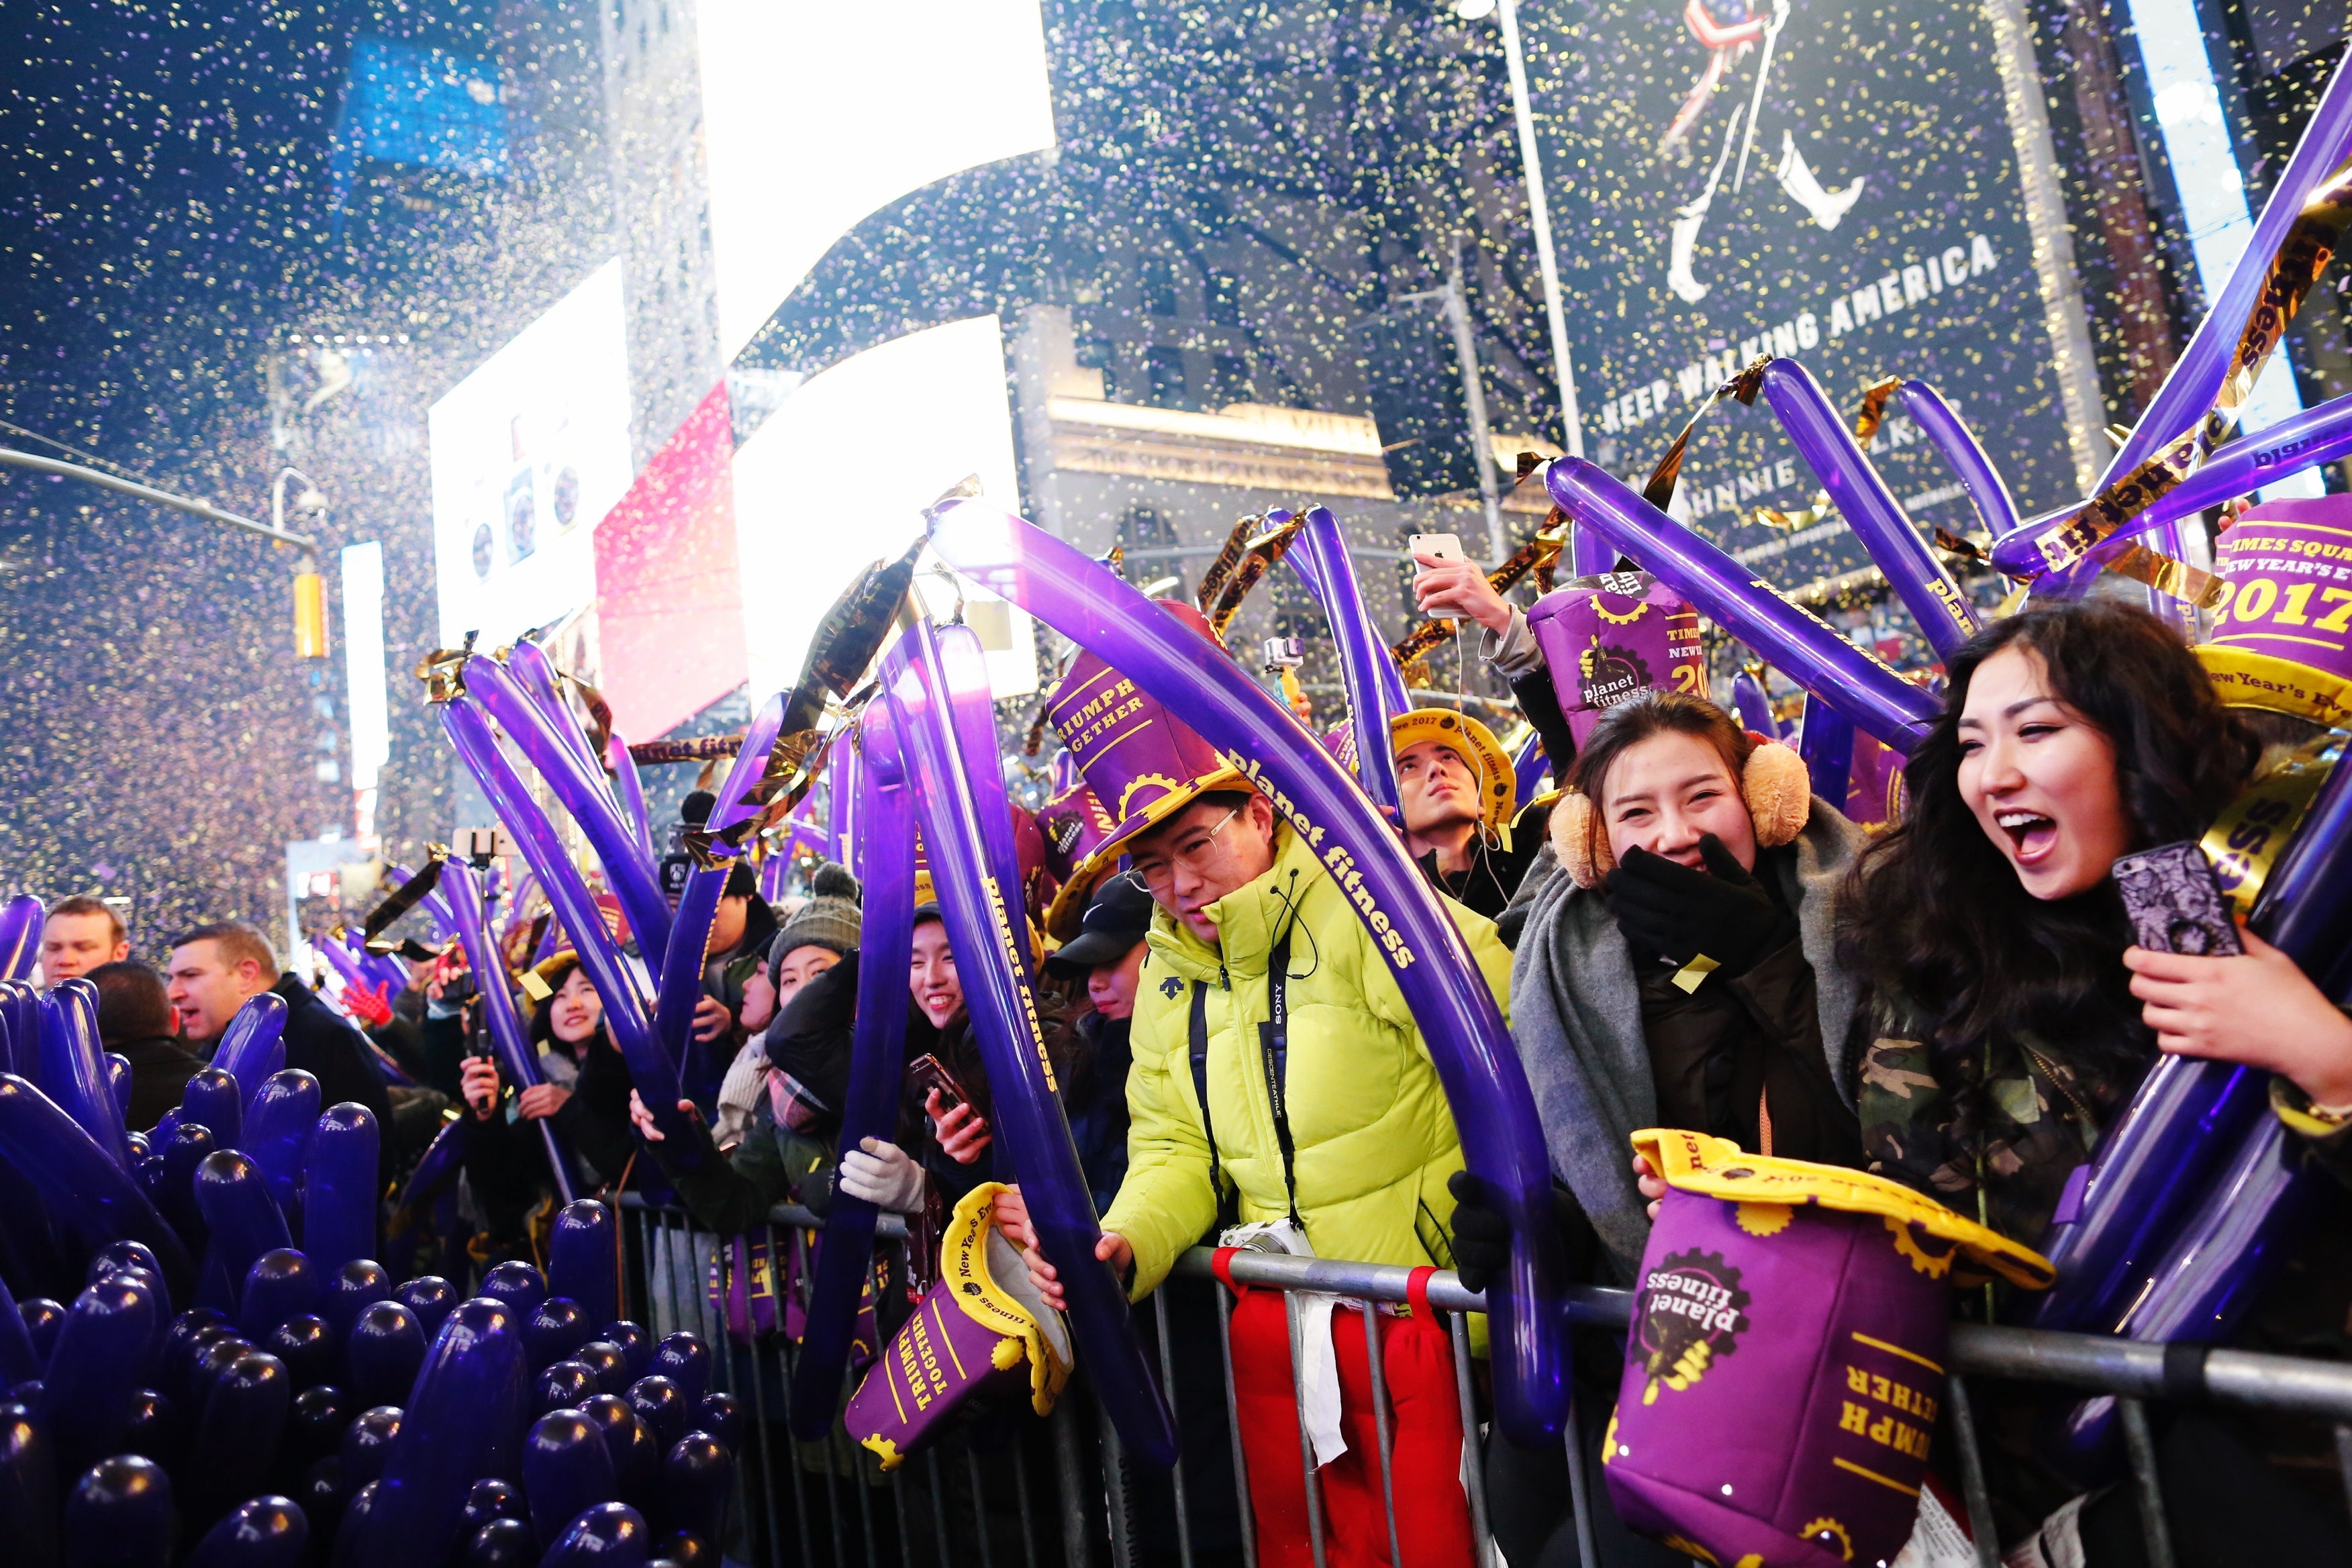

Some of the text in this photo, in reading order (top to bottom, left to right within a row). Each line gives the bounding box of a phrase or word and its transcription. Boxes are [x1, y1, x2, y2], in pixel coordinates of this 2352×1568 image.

[1602, 378, 1669, 436] KEEP
[1830, 233, 1998, 336] AMERICA
[2257, 558, 2333, 577] YEAR'S
[2212, 578, 2352, 634] 2017
[1583, 673, 1634, 703] planet
[1671, 663, 1711, 699] 20
[2210, 671, 2234, 683] ew
[2236, 671, 2305, 699] Year's
[1412, 716, 1438, 726] 2017
[1453, 725, 1487, 753] planet
[1481, 752, 1501, 781] fitness
[1491, 801, 1504, 826] New
[1057, 822, 1076, 854] planet
[1228, 748, 1326, 848] planet
[1322, 845, 1416, 970] fitness
[979, 875, 1059, 1093] planet fitness
[1275, 983, 1283, 1025] SONY
[958, 1249, 972, 1278] New
[979, 1296, 1027, 1325] fitness
[1646, 1272, 1734, 1311] fitness
[1649, 1293, 1741, 1332] planet
[912, 1311, 948, 1395] TOGETHER
